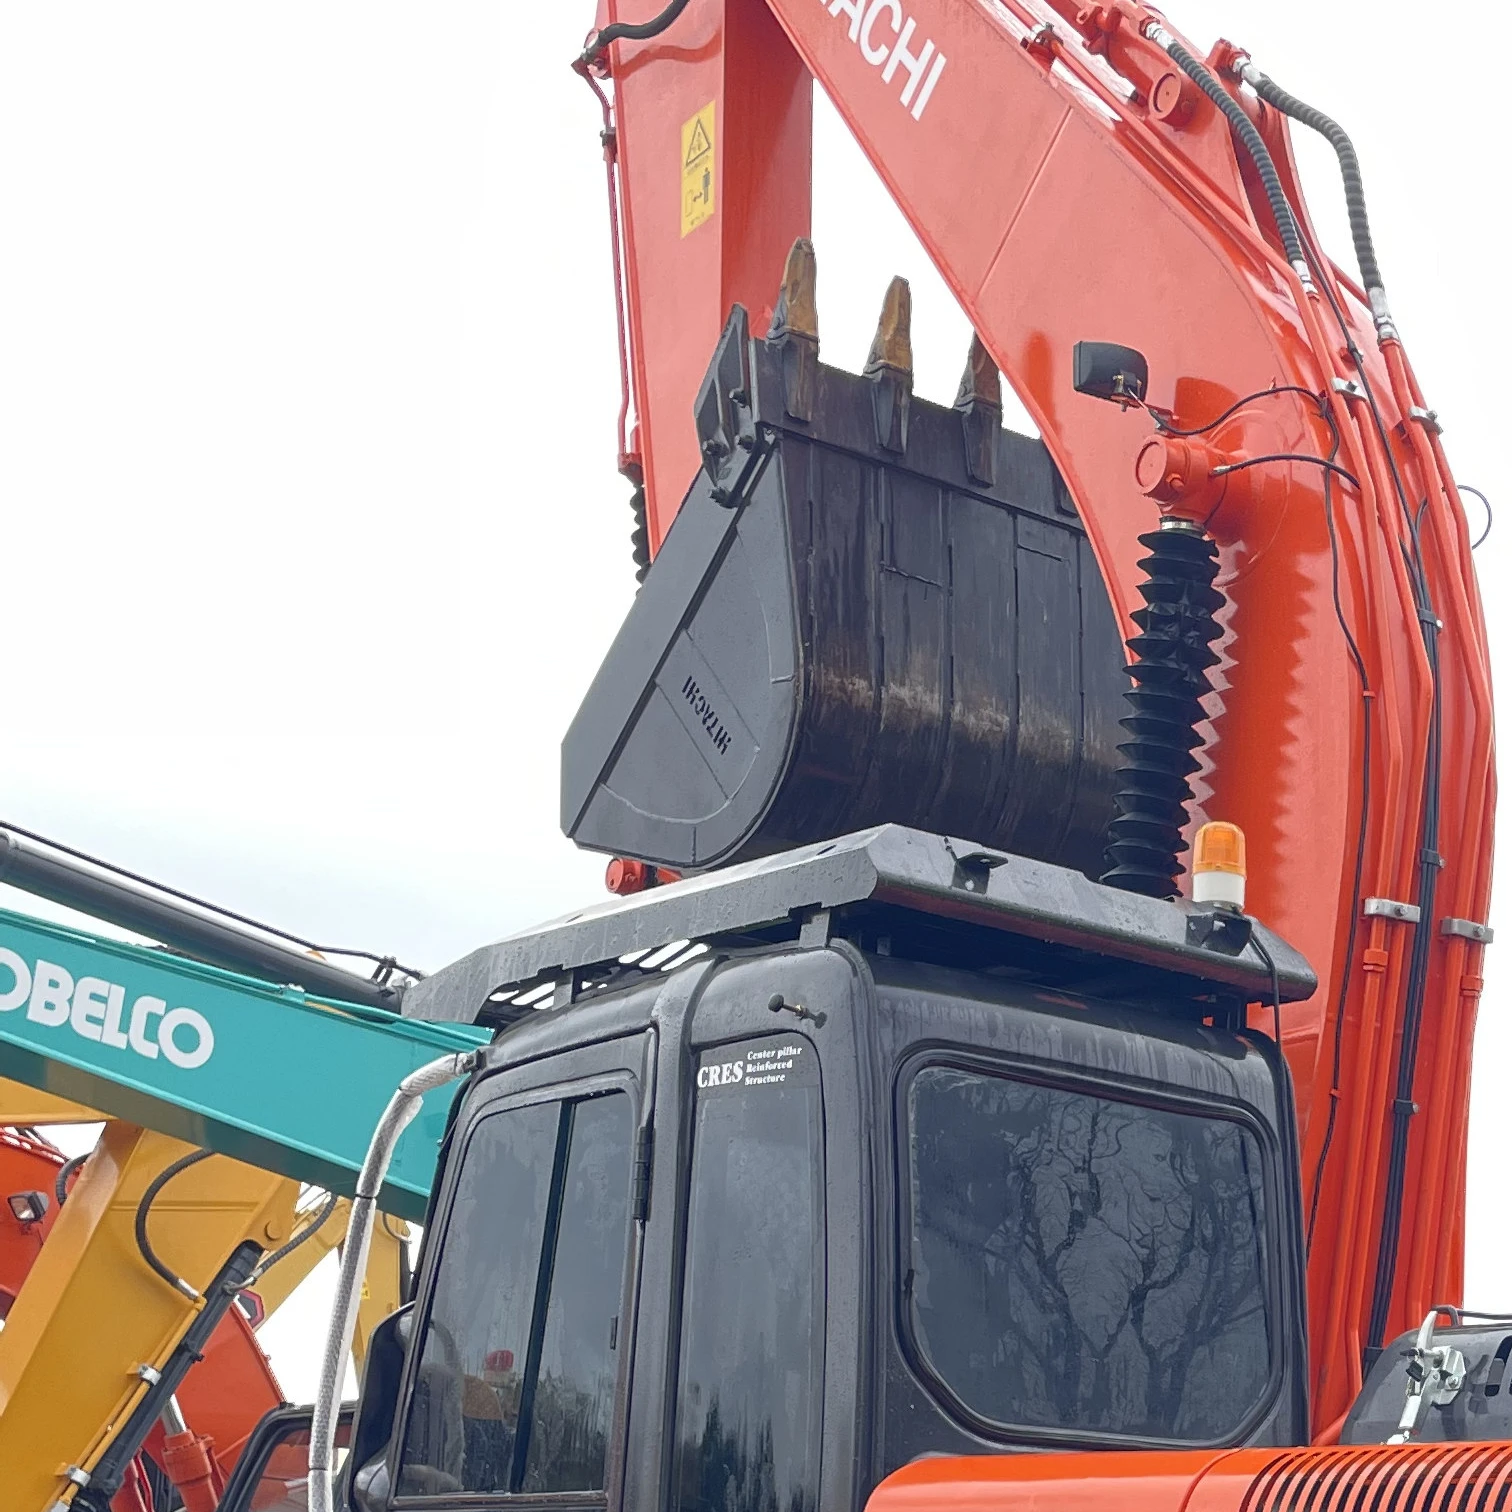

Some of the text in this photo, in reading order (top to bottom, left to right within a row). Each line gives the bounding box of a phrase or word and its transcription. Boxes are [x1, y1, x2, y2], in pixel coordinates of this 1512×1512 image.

[820, 0, 947, 122] ACHI
[681, 675, 732, 756] HITACHI
[747, 1045, 802, 1060] Center pillar
[697, 1060, 744, 1088] CRES
[746, 1059, 793, 1073] Reinforced
[744, 1073, 786, 1086] Structure
